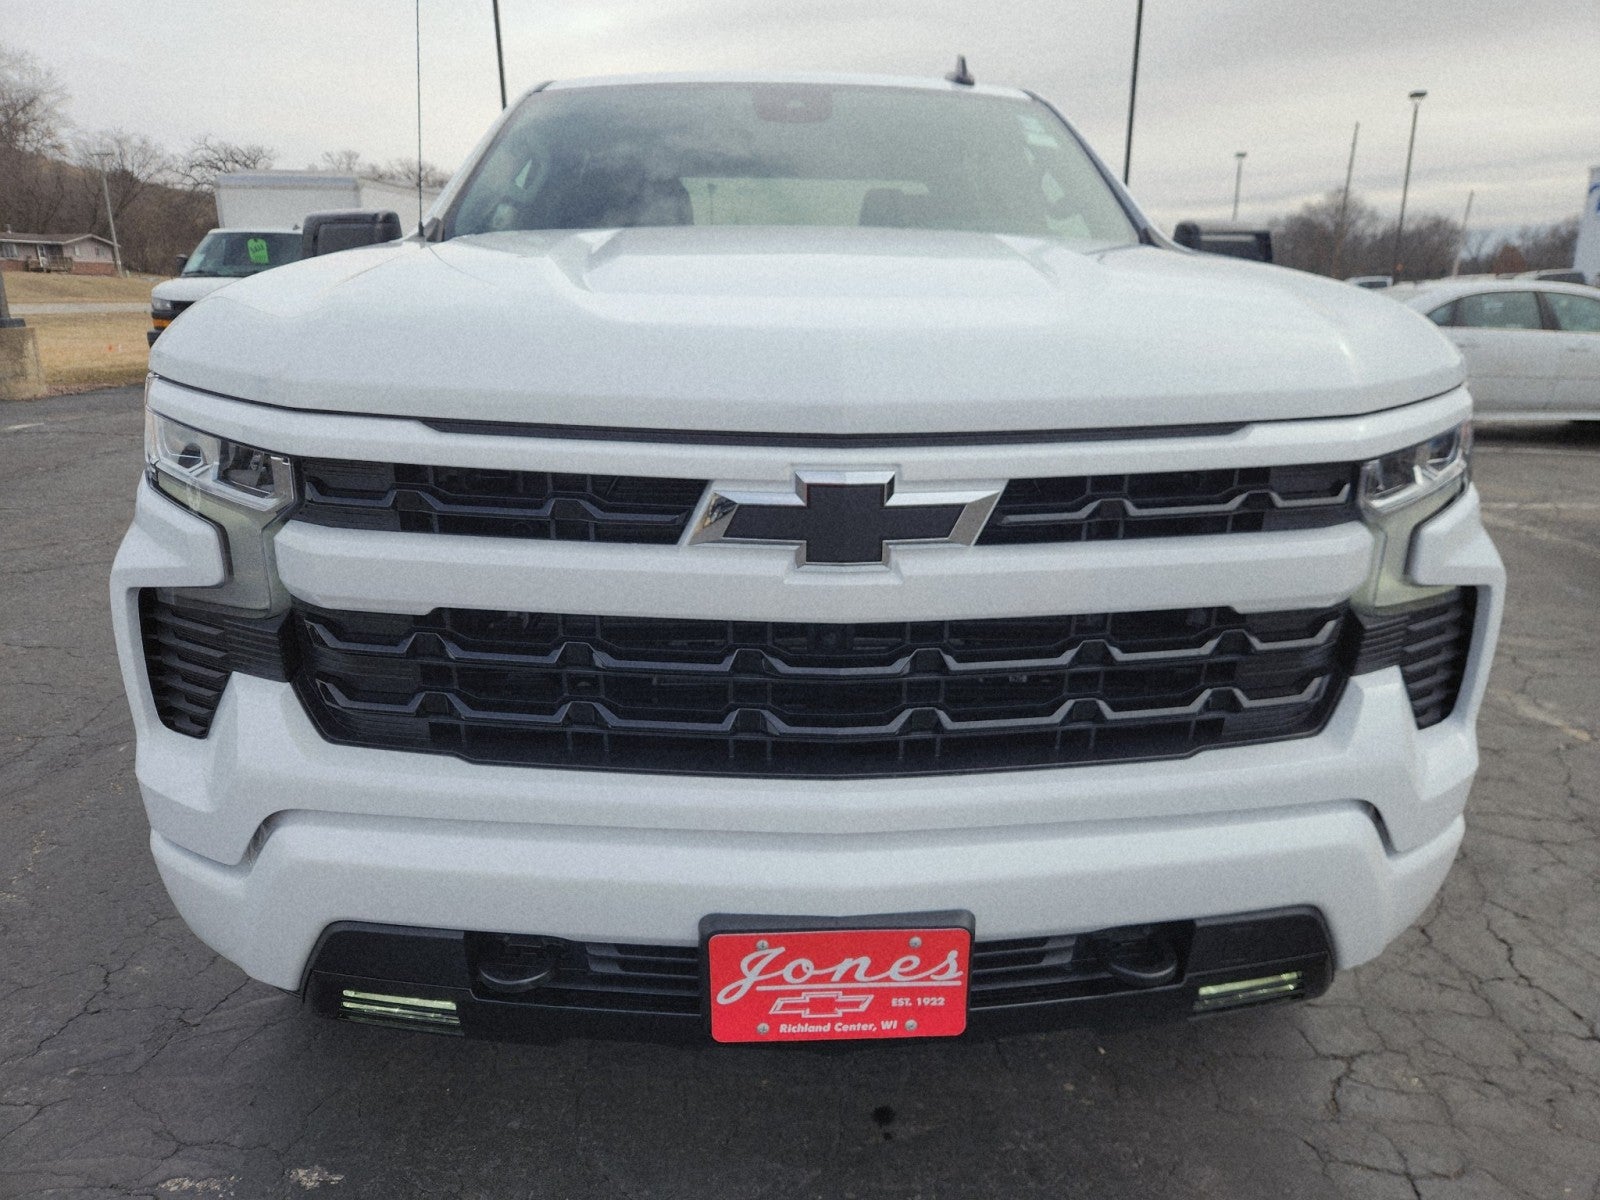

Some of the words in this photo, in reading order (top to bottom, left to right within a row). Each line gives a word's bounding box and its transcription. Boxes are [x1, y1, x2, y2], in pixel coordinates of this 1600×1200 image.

[716, 946, 963, 1005] Jones
[891, 997, 912, 1007] EST.
[917, 997, 945, 1006] 1922
[780, 1023, 830, 1033] Richland
[834, 1022, 877, 1032] Center,
[881, 1020, 898, 1030] WI
